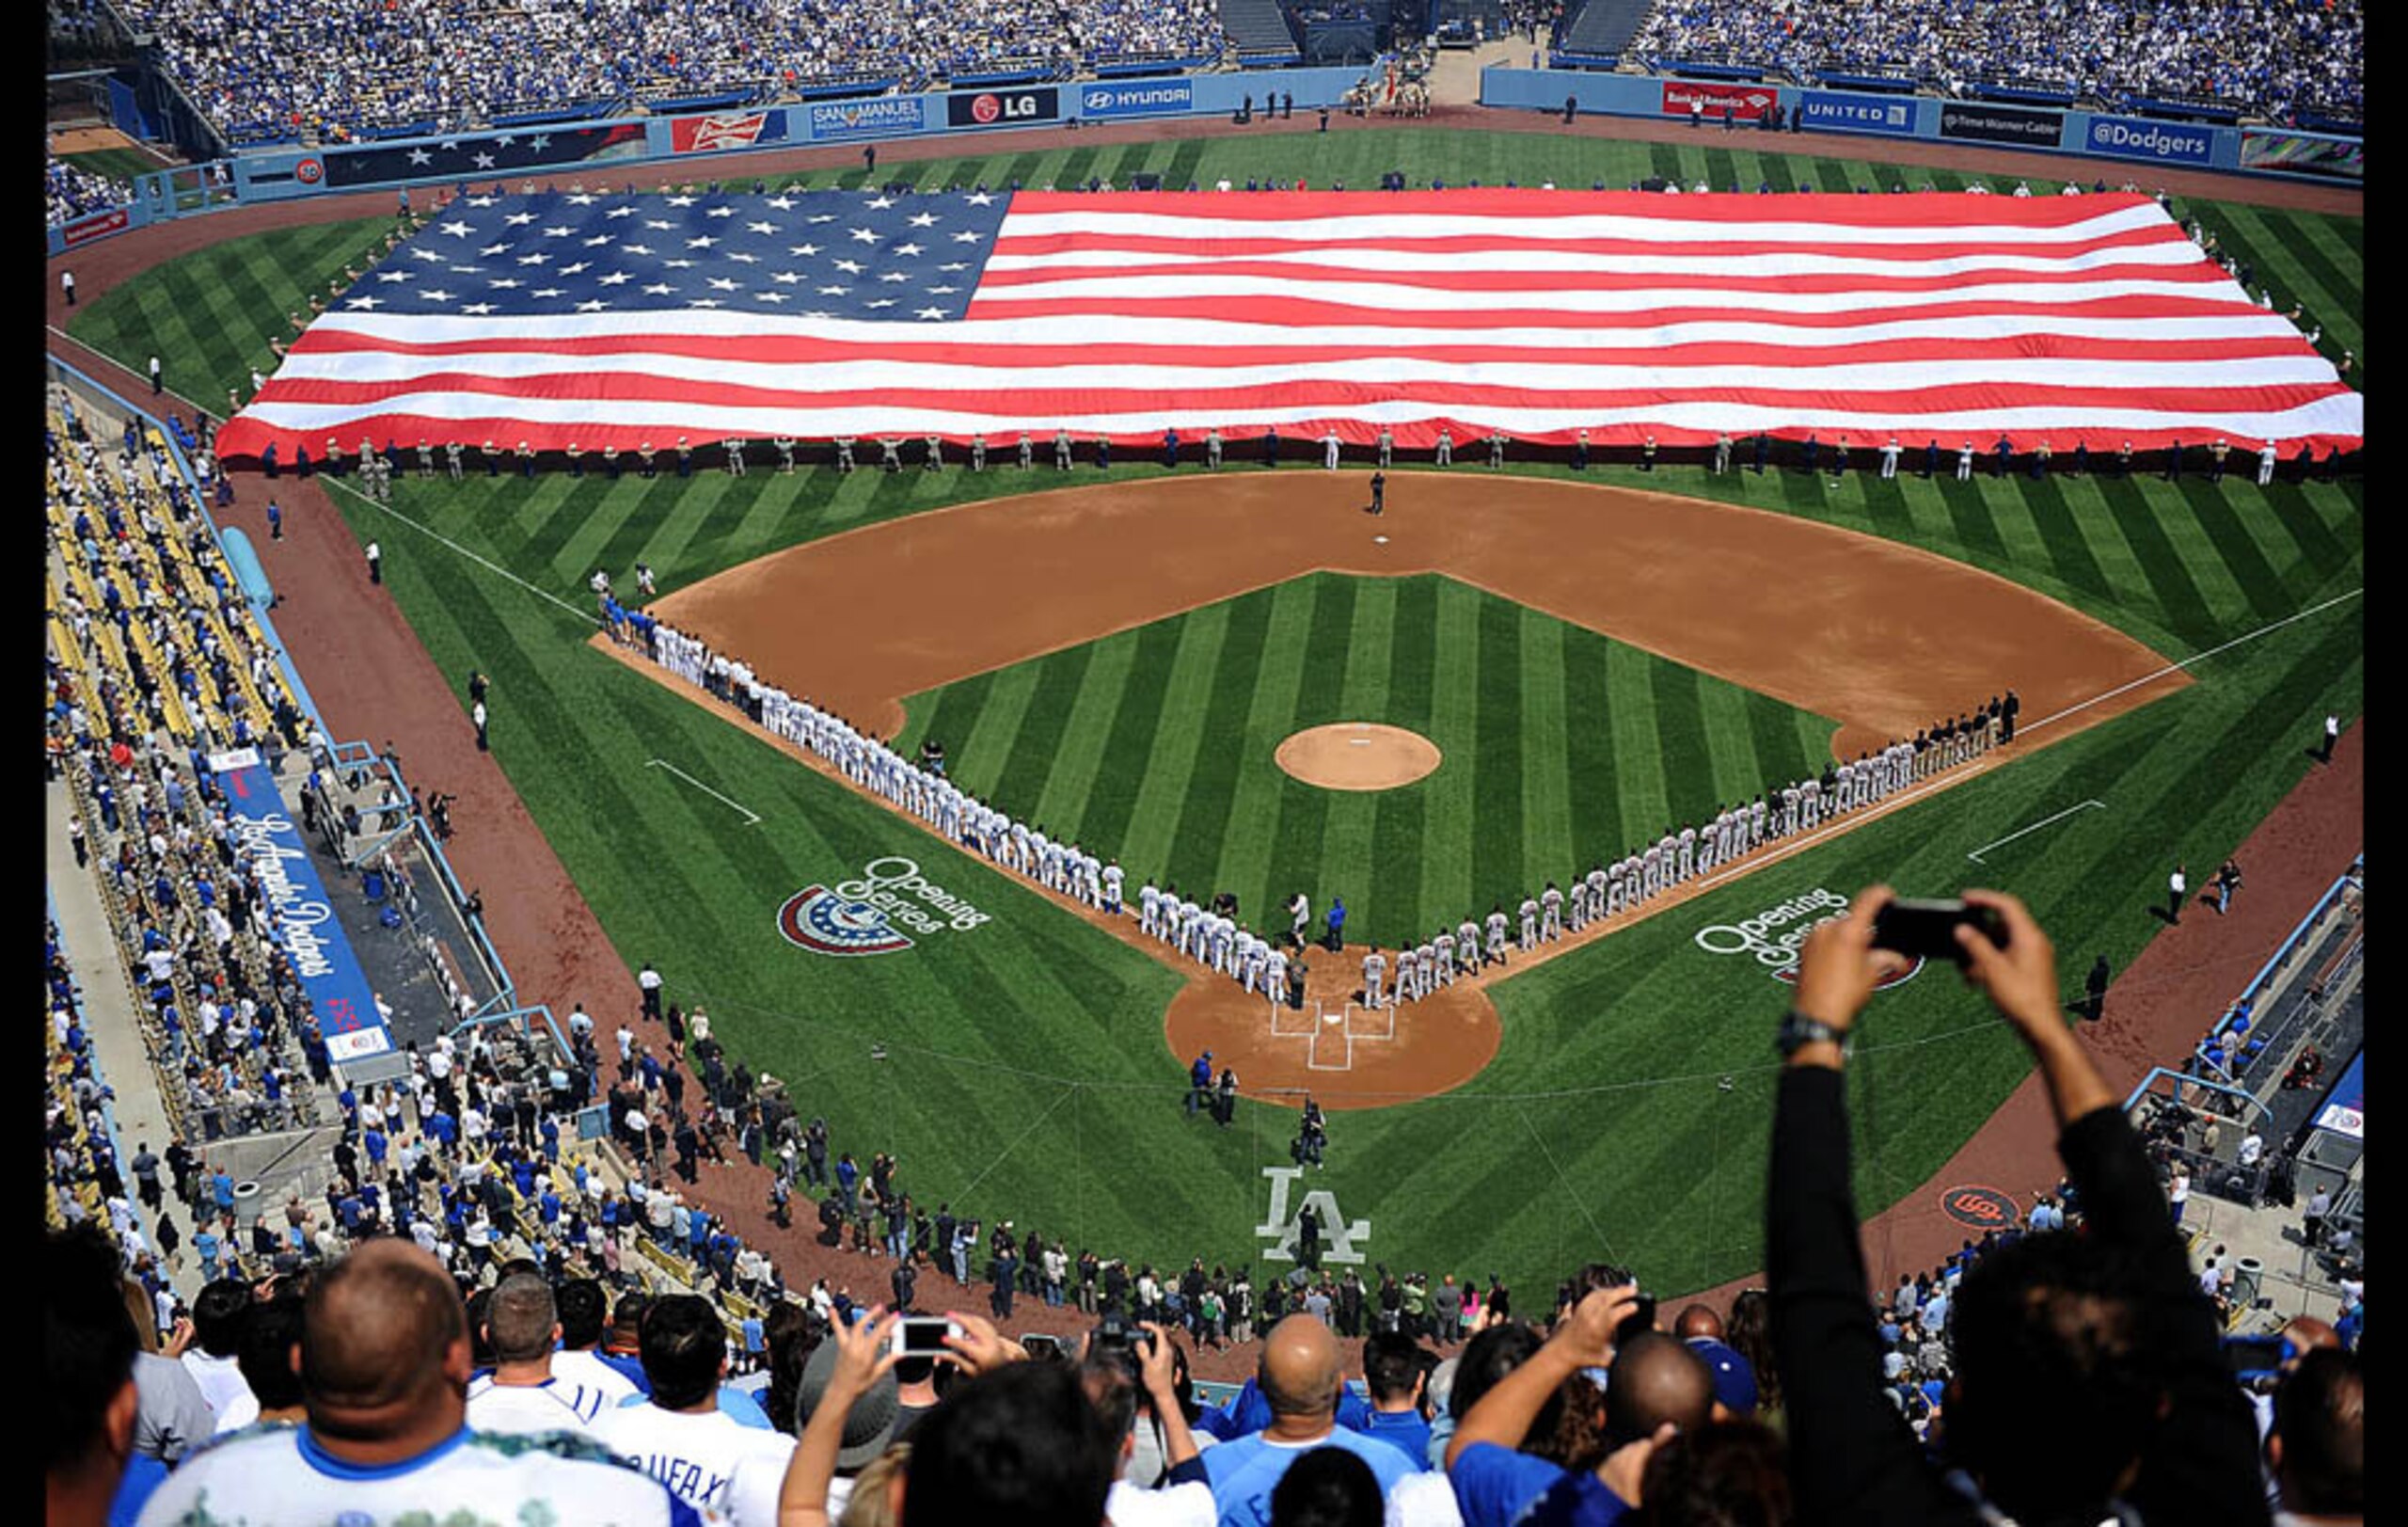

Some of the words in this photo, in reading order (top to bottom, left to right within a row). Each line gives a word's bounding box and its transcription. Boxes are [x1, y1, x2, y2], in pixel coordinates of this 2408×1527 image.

[1005, 97, 1037, 117] LG
[1117, 89, 1190, 105] HYUNDAI
[1668, 92, 1691, 103] Bank
[1705, 95, 1744, 108] America
[814, 104, 847, 123] SAN
[857, 100, 919, 117] MANUEL
[1808, 103, 1883, 120] UNITED
[1959, 115, 1985, 127] Time
[1986, 119, 2025, 131] Warner
[2094, 123, 2206, 153] @Dodgers
[864, 857, 991, 931] Opening
[836, 881, 944, 932] Series
[1695, 888, 1847, 953] Opening
[1255, 1165, 1371, 1265] LA
